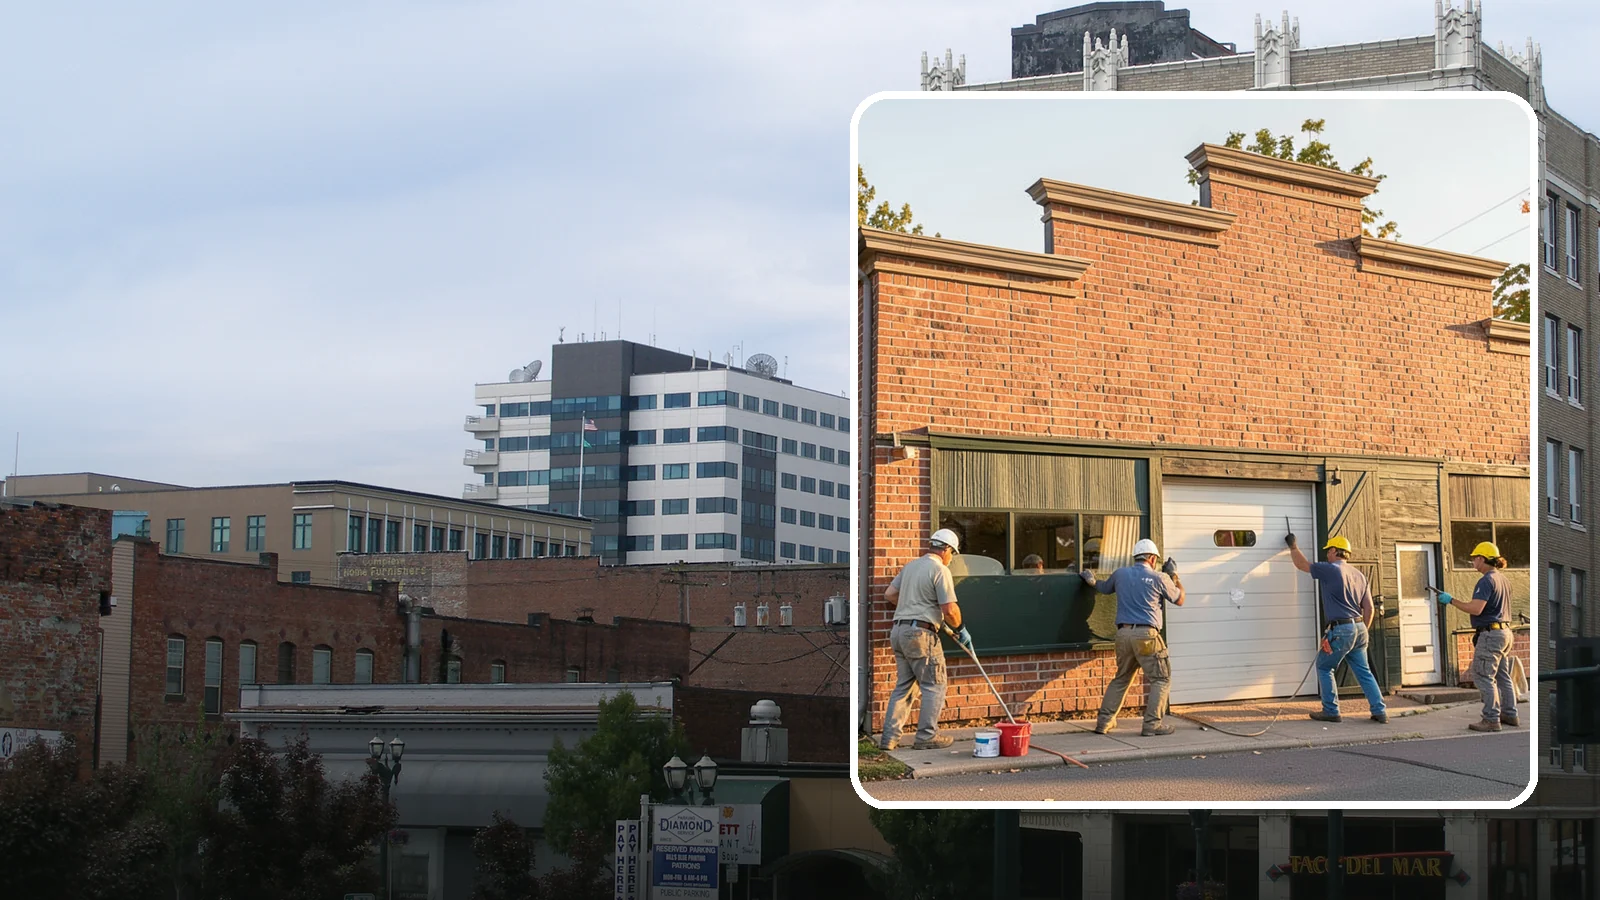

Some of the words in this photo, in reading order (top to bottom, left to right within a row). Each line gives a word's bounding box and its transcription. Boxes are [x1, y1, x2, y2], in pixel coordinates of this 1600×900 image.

[343, 568, 367, 577] Home
[371, 566, 427, 577] Furnishers
[660, 818, 713, 832] DIAMOND
[1021, 815, 1070, 828] BUILDING
[617, 825, 625, 852] PAY
[628, 824, 637, 852] PAY
[656, 845, 688, 853] RESERVED
[689, 846, 716, 854] PARKING
[721, 851, 739, 861] Soup
[671, 862, 701, 870] PATRONS
[1346, 856, 1384, 875] DEL
[1392, 856, 1442, 876] MAR
[616, 856, 625, 893] HERE
[627, 856, 636, 893] HERE
[660, 889, 682, 897] PUBLIC
[684, 890, 710, 898] PARKING
